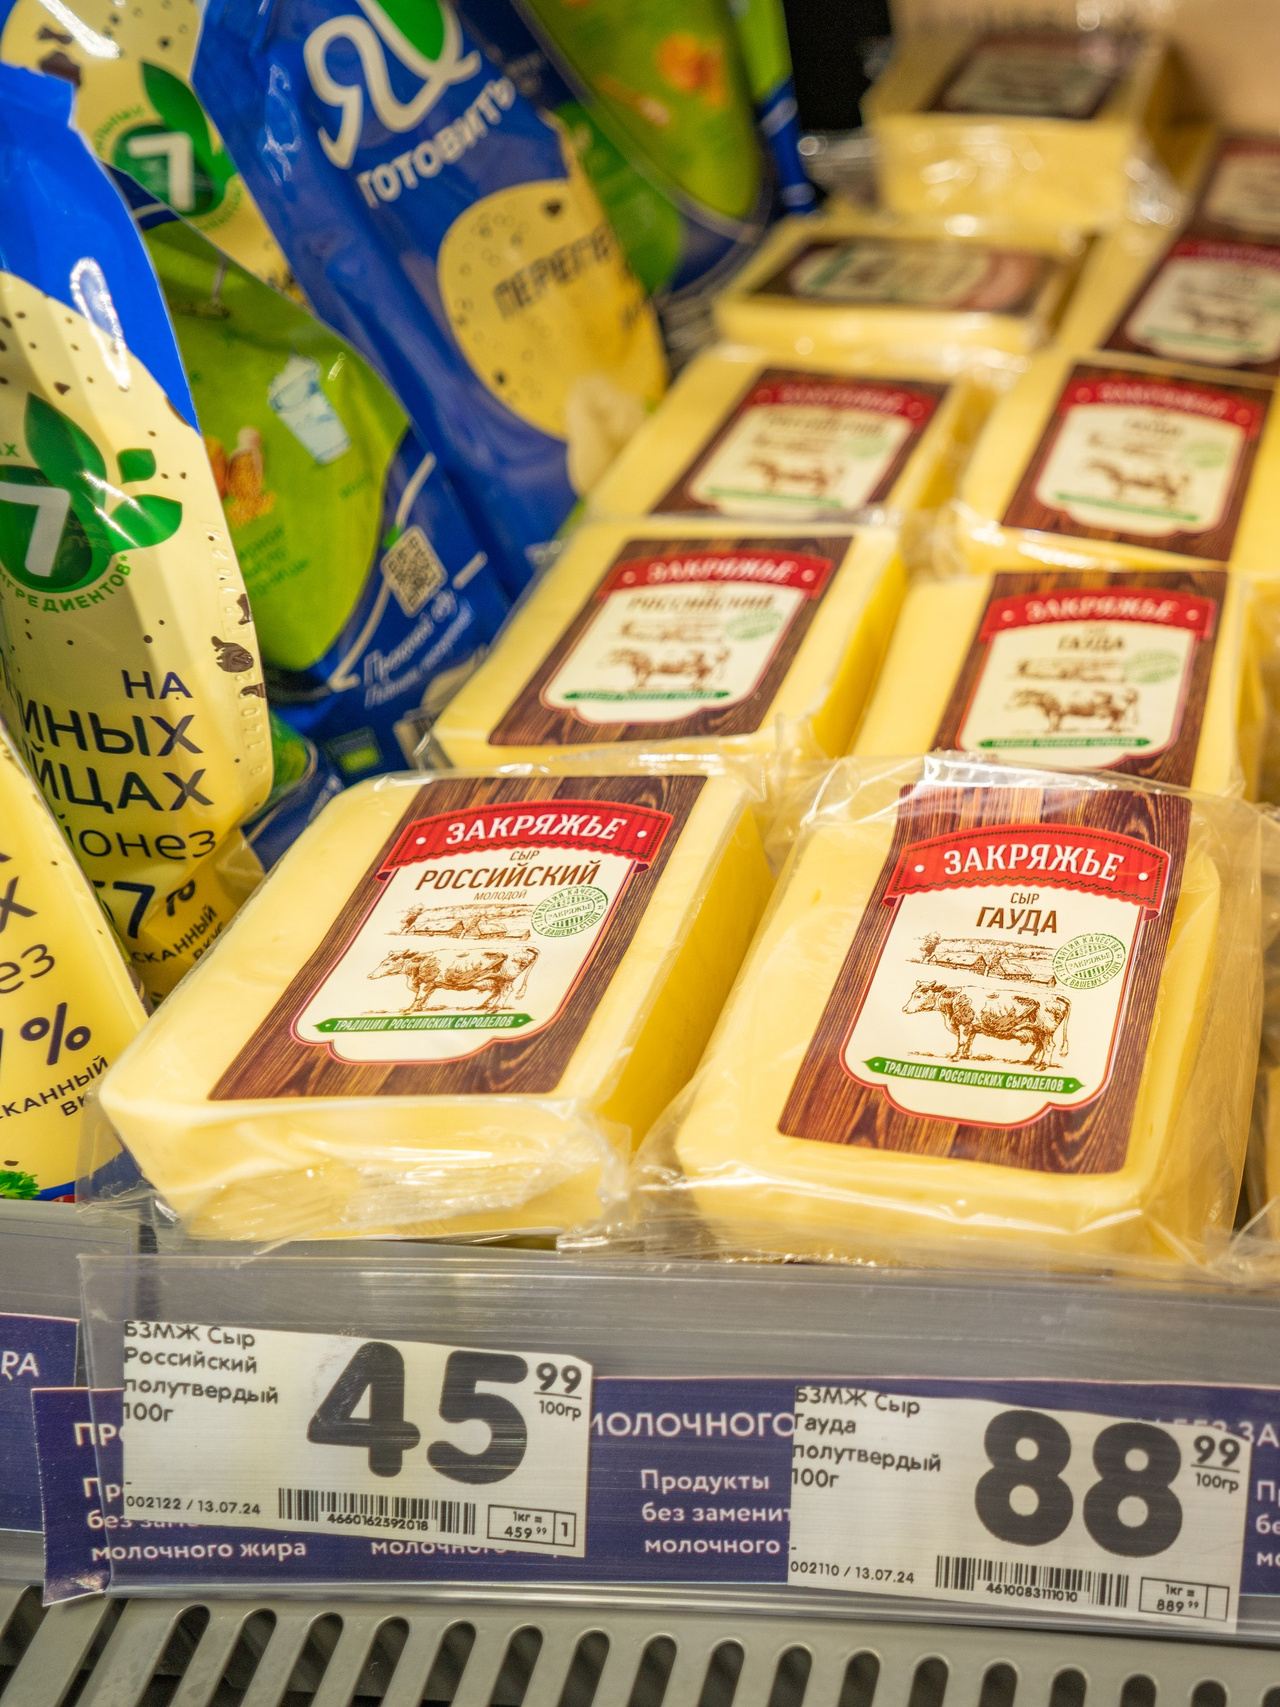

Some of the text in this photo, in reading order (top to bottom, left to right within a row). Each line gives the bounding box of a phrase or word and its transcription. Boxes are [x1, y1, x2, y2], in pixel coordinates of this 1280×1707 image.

[356, 76, 516, 208] ГОТОВИТЬ
[126, 131, 195, 213] 7
[0, 481, 72, 578] 7
[121, 669, 194, 700] НА
[446, 812, 628, 846] ЗАКРЯЖЬЕ
[509, 848, 540, 862] СЫР
[943, 842, 1126, 882] ЗАКРЯЖЬЕ
[415, 857, 603, 892] РОССИЙСКИЙ
[473, 888, 528, 902] МОЛОДОЙ
[1009, 891, 1040, 906] СЫР
[975, 906, 1059, 937] ГАУДА
[131, 904, 219, 965] СКАННЫЙ
[333, 1018, 388, 1032] ТРАДИЦИИ
[455, 1015, 516, 1028] СЫРОДЕЛОВ
[0, 1054, 109, 1120] КАННЫЙ
[883, 1060, 938, 1080] ТРАДИЦИИ
[1005, 1075, 1066, 1093] СЫРОДЕЛОВ
[124, 1320, 256, 1350] БЗМЖ Сыр
[0, 1351, 40, 1381] РА
[124, 1346, 257, 1375] Российский
[124, 1378, 279, 1405] полутвердый
[795, 1386, 921, 1418] БЗМЖ Сыр
[123, 1402, 173, 1423] 100г
[307, 1340, 583, 1486] 45 99
[538, 1400, 583, 1422] 100гр
[794, 1413, 857, 1435] Гауда
[792, 1444, 942, 1472] полутвердый
[640, 1468, 770, 1496] Продукты
[790, 1468, 839, 1489] 100г
[973, 1409, 1241, 1559] 88 99
[1195, 1472, 1240, 1495] 100гр
[126, 1495, 182, 1511] 002122
[198, 1499, 261, 1516] 13.07.24
[512, 1510, 531, 1524] 1кг
[641, 1501, 791, 1523] без заменит
[326, 1513, 429, 1531] 4660162592018
[504, 1525, 547, 1540] 459 99
[561, 1521, 569, 1539] 1
[92, 1541, 307, 1564] молочного жира
[645, 1538, 781, 1555] молочного
[790, 1561, 840, 1577] 002110
[855, 1566, 915, 1585] 13.07.24
[985, 1582, 1078, 1603] 4610083111010
[1165, 1583, 1183, 1597] 1кг
[1155, 1598, 1200, 1614] 889 99
